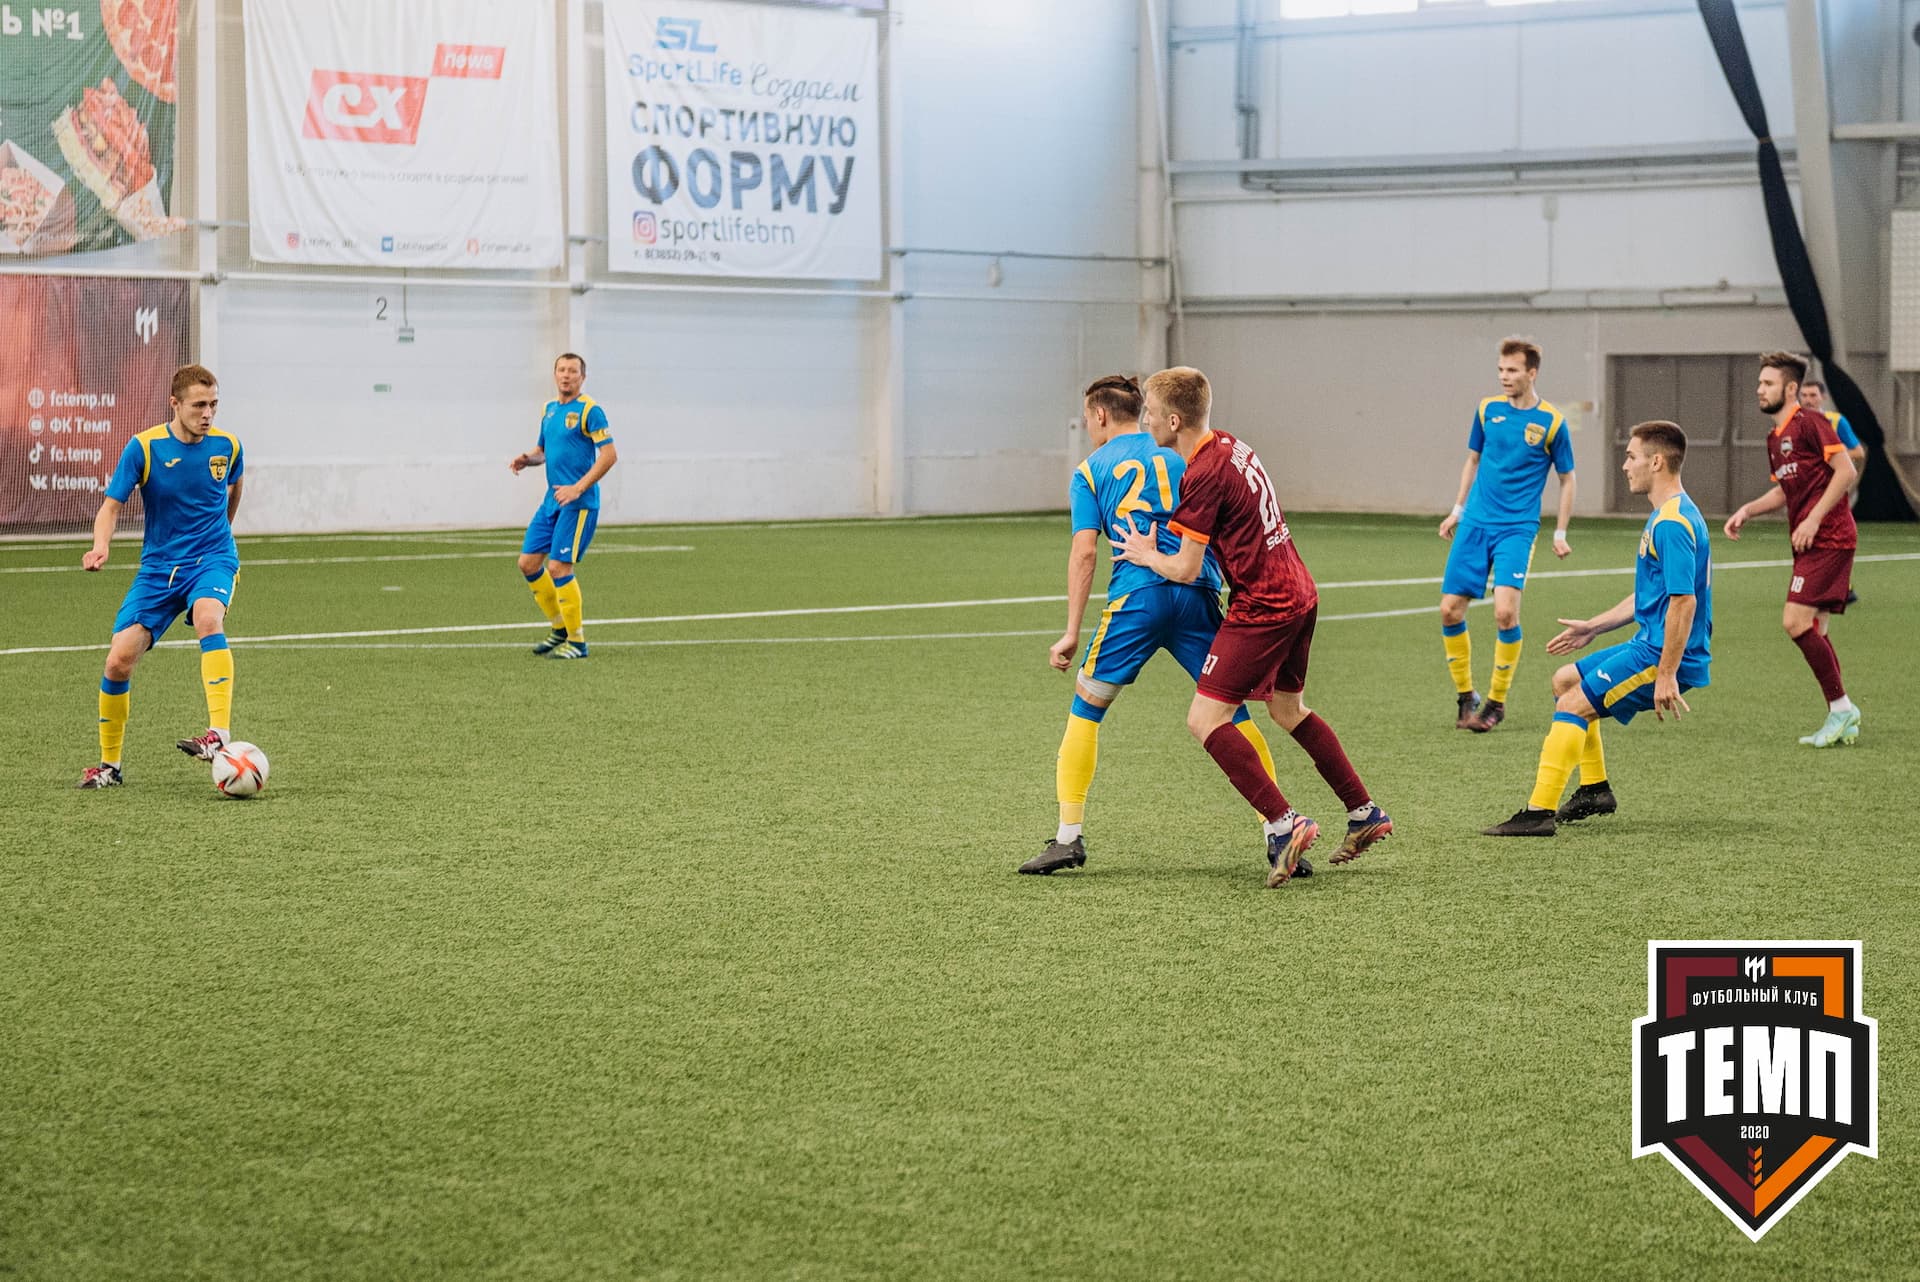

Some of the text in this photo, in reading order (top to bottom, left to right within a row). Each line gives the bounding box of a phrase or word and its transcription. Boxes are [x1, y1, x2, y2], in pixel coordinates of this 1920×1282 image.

[32, 7, 85, 41] №1
[442, 50, 494, 71] news
[630, 100, 857, 149] СПОРТИВНУЮ
[631, 144, 856, 216] ФОРМУ
[660, 216, 795, 246] sportlifebrn
[376, 296, 388, 321] 2
[50, 389, 116, 411] fctemp.ru
[50, 416, 112, 434] ФК Темп
[50, 444, 102, 465] fc.temp
[1112, 455, 1173, 518] 21
[1790, 575, 1805, 594] 18
